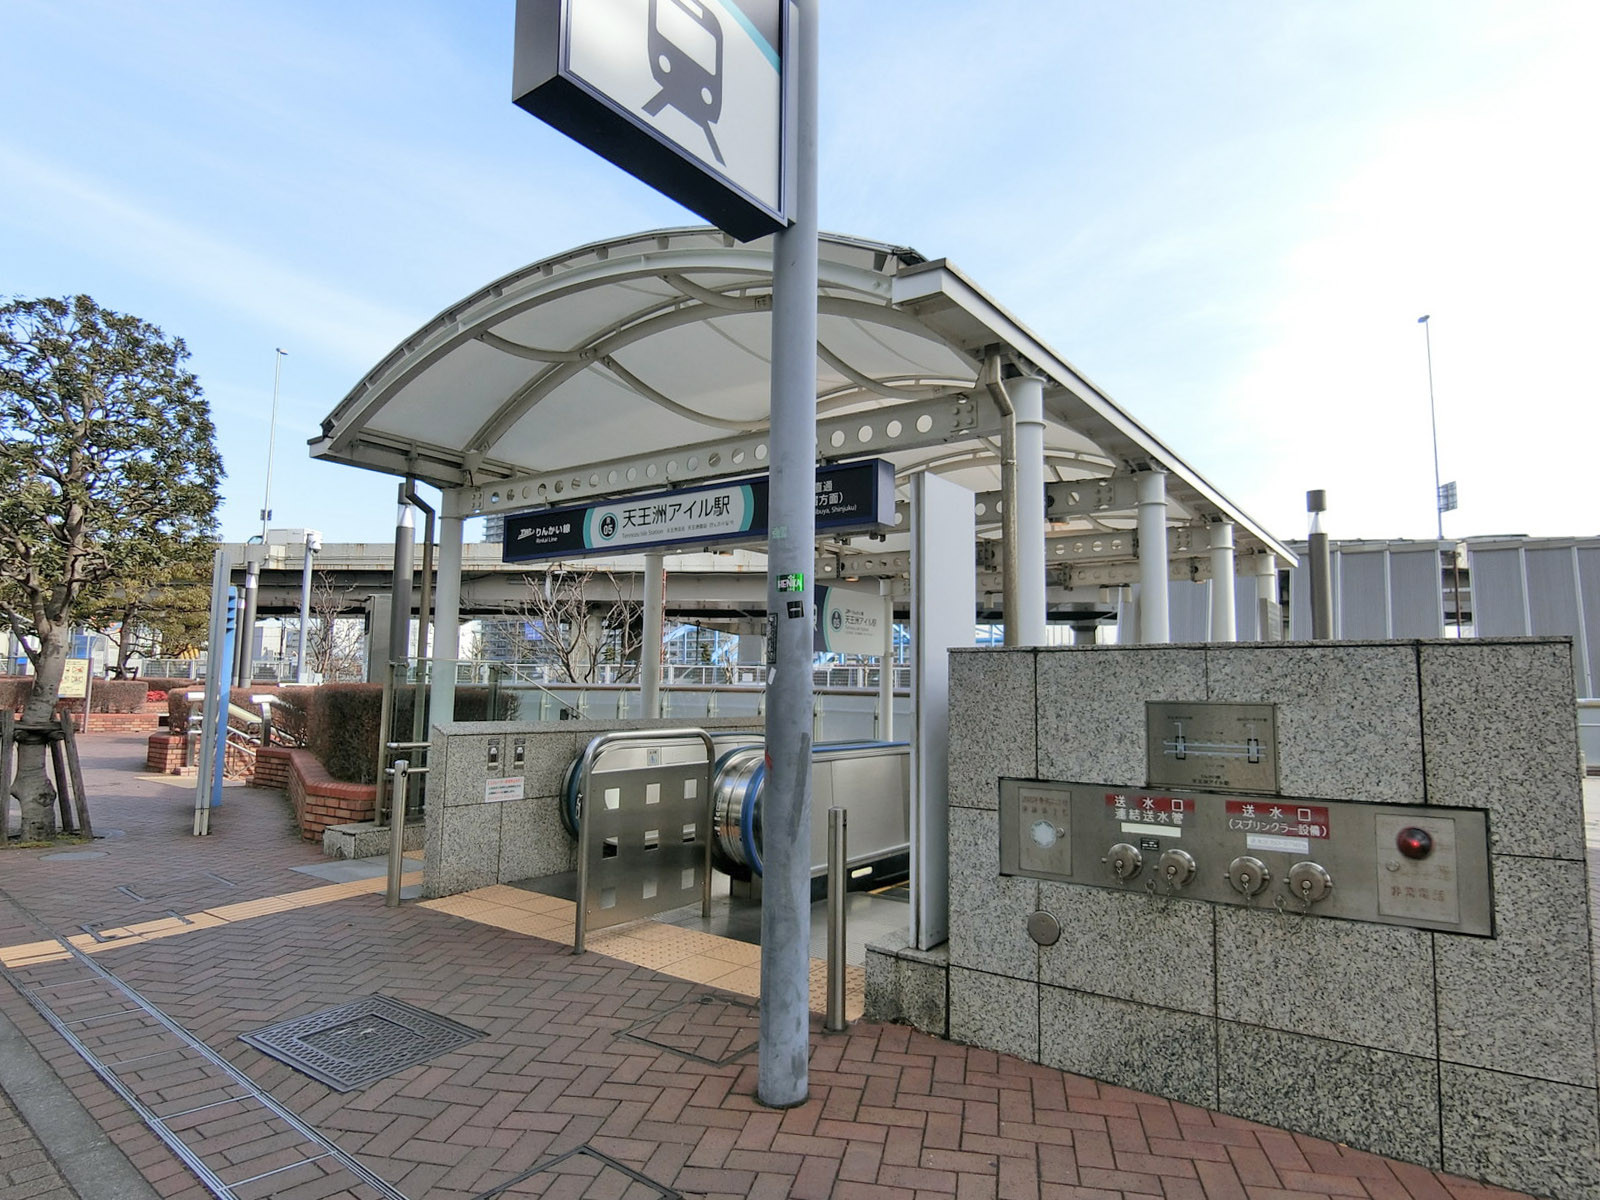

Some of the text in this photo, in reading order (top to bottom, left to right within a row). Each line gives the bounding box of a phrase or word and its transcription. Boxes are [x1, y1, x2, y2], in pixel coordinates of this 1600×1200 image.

[622, 495, 730, 529] 天王洲アイル駅
[535, 523, 571, 537] りんかい線
[603, 524, 613, 535] 05
[1114, 808, 1184, 824] 連結送水管
